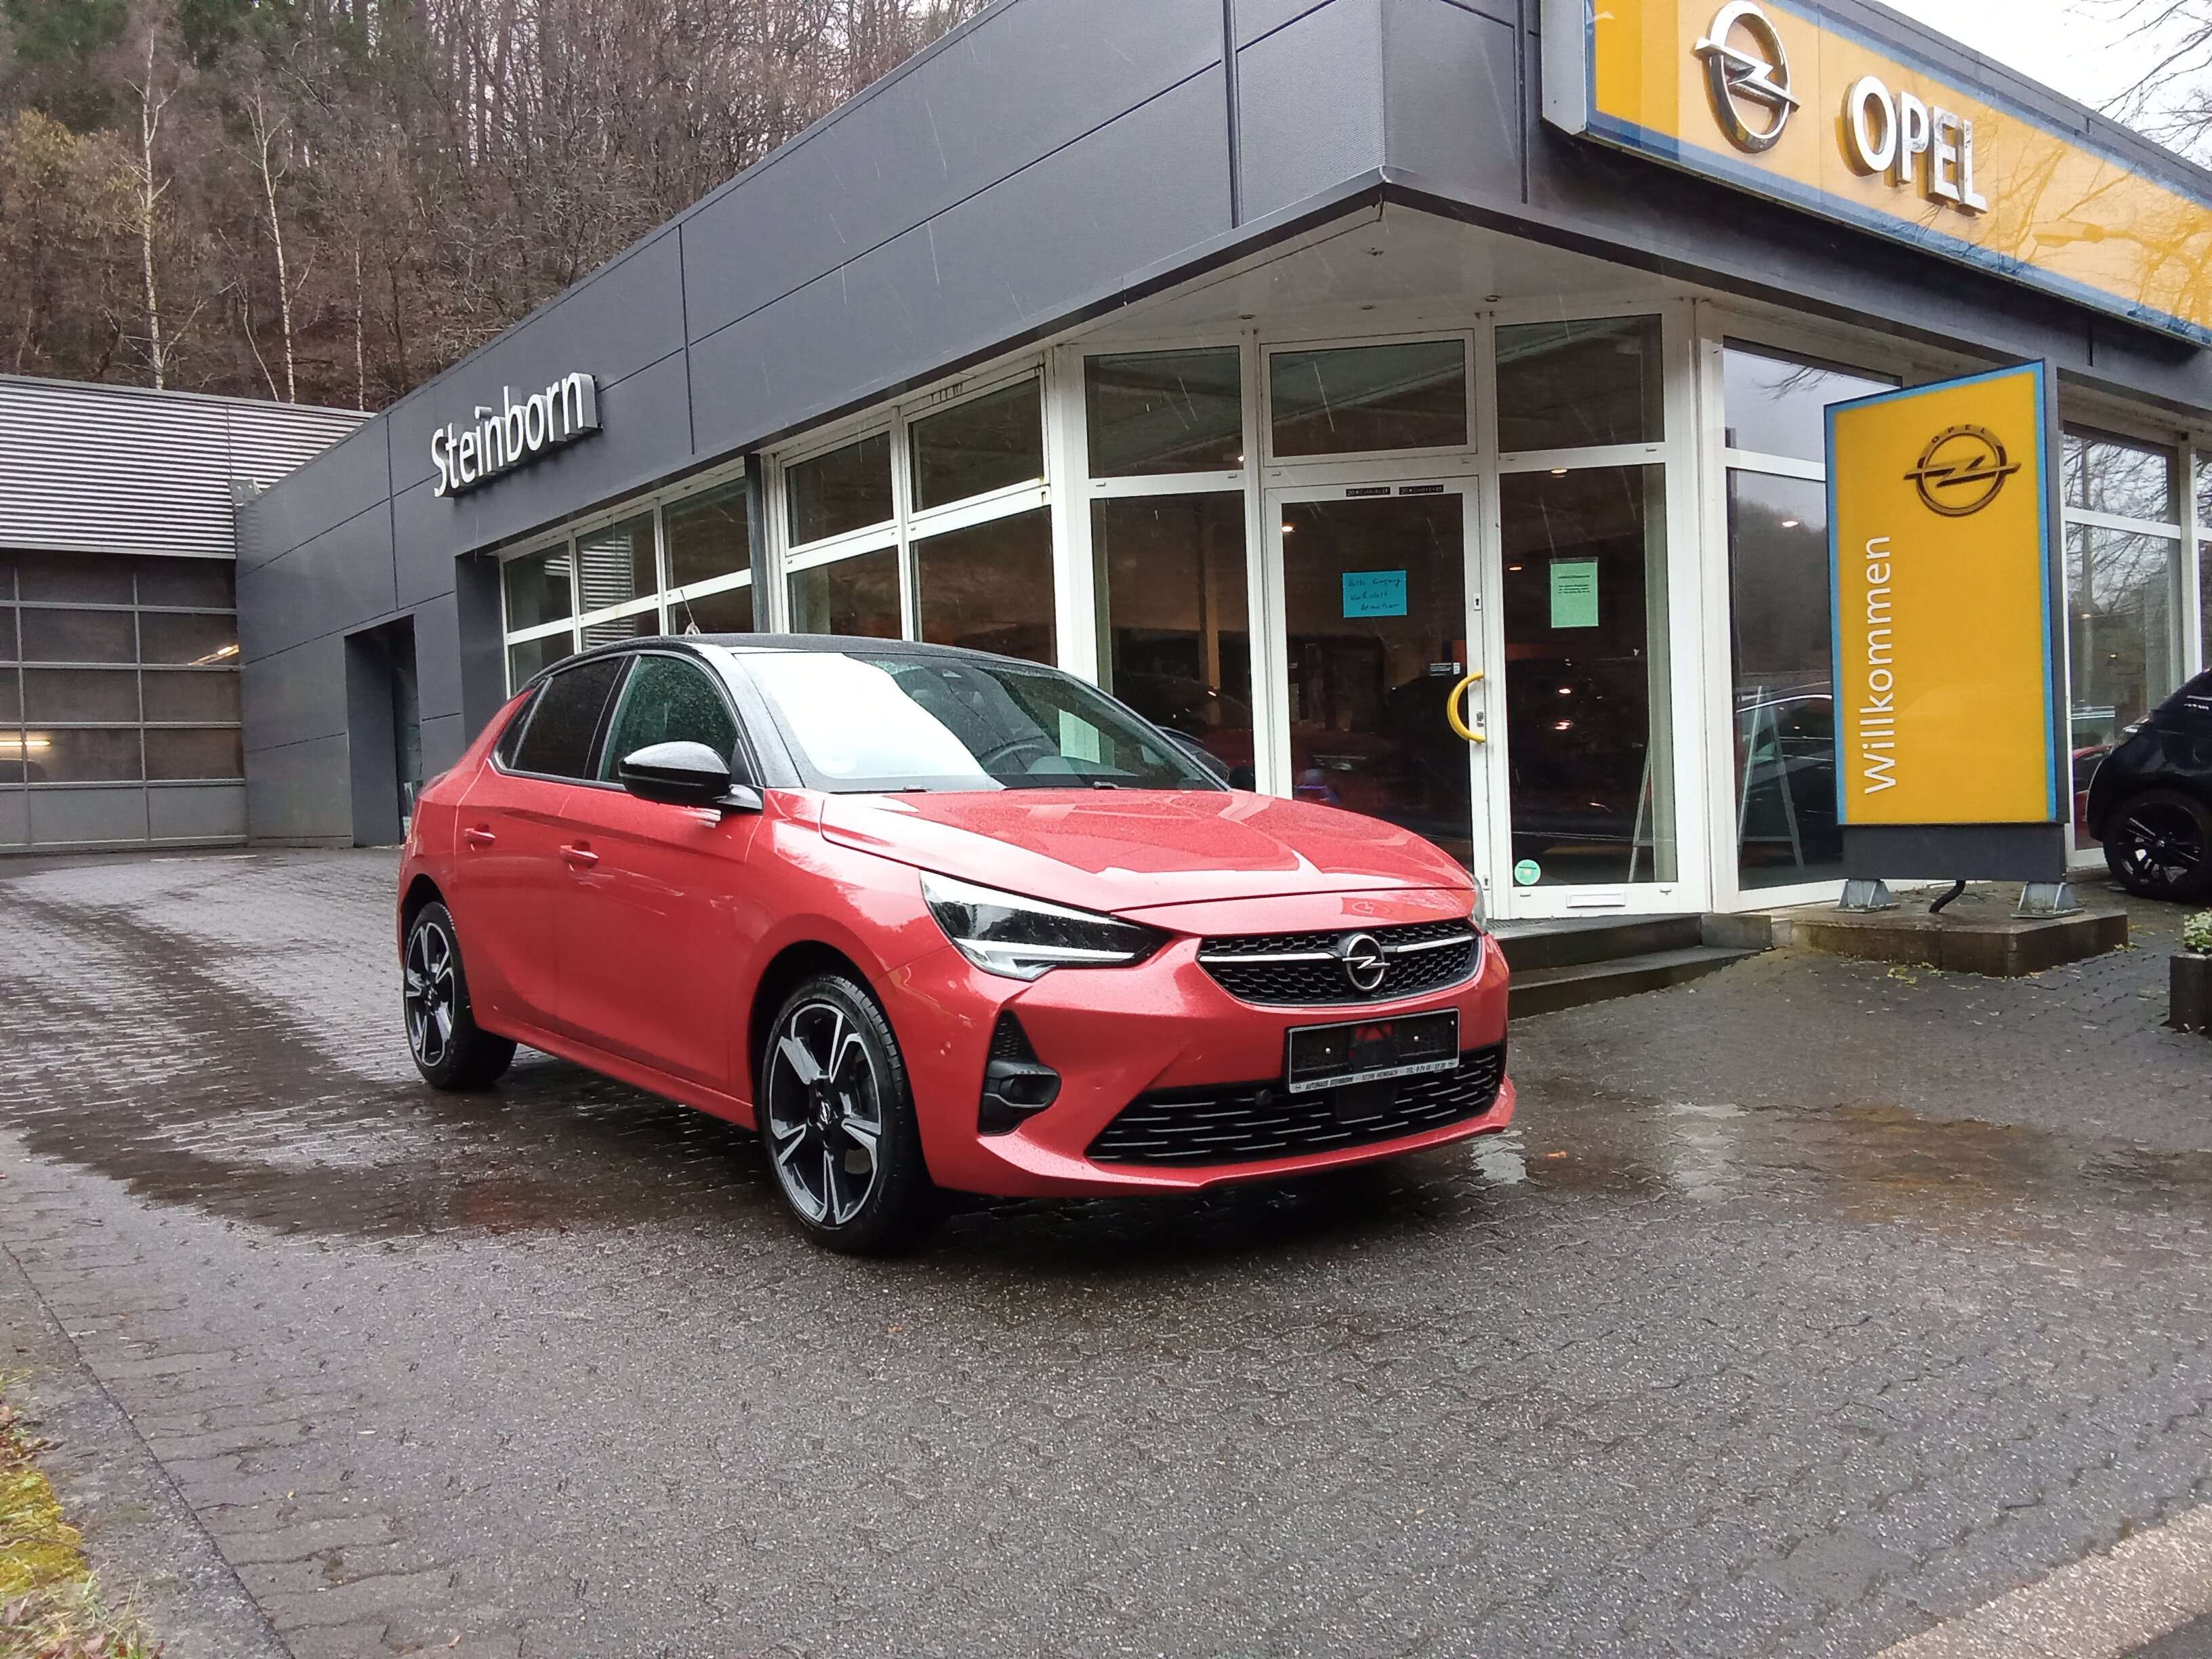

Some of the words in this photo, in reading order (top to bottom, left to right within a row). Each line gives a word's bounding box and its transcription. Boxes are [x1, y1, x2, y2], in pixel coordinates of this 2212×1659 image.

[1845, 75, 1987, 214] OPEL
[432, 372, 594, 497] Steinborn
[1931, 424, 1986, 443] OPEL
[1859, 536, 1896, 794] Willkommen
